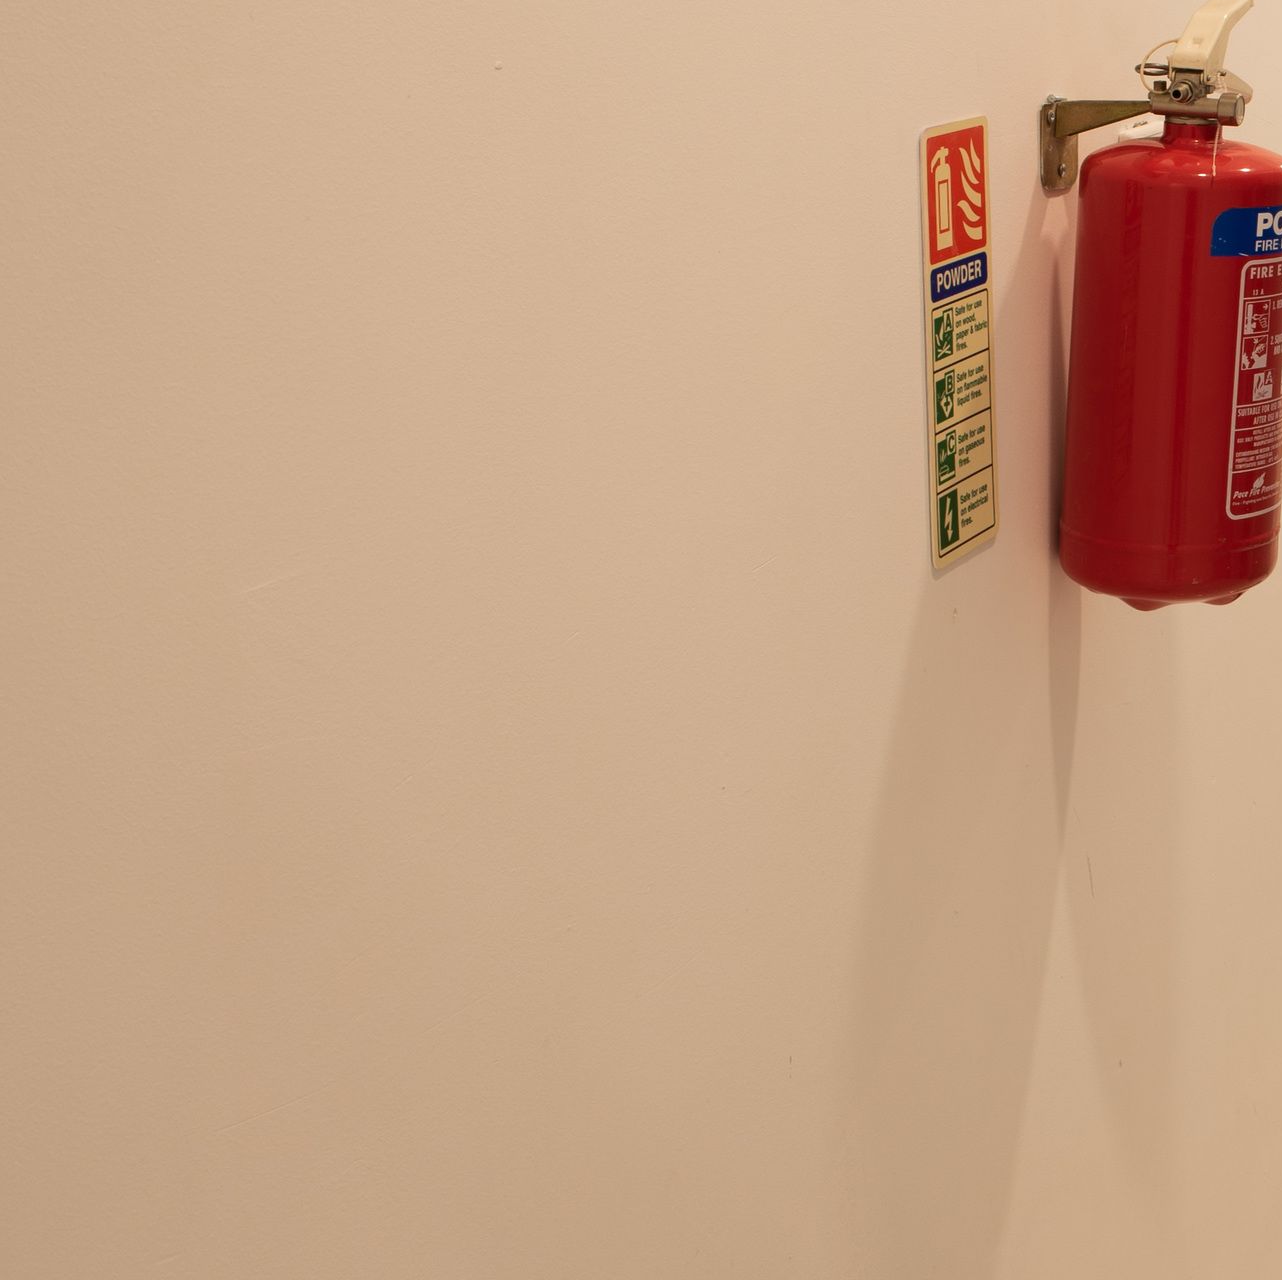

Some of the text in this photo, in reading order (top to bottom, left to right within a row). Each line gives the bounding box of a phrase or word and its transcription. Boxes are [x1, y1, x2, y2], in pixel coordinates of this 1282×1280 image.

[1255, 238, 1279, 252] FIRE
[936, 259, 982, 293] POWDER
[1250, 265, 1274, 280] FIRE
[955, 306, 966, 317] Safe
[974, 299, 982, 309] use
[956, 320, 962, 328] on
[956, 328, 969, 341] paper
[956, 372, 967, 383] Safe
[975, 364, 984, 374] use
[956, 385, 963, 394] on
[957, 433, 968, 444] Safe
[976, 424, 985, 434] use
[958, 447, 965, 456] on
[960, 493, 971, 504] Safe
[978, 483, 987, 493] use
[960, 506, 967, 516] on
